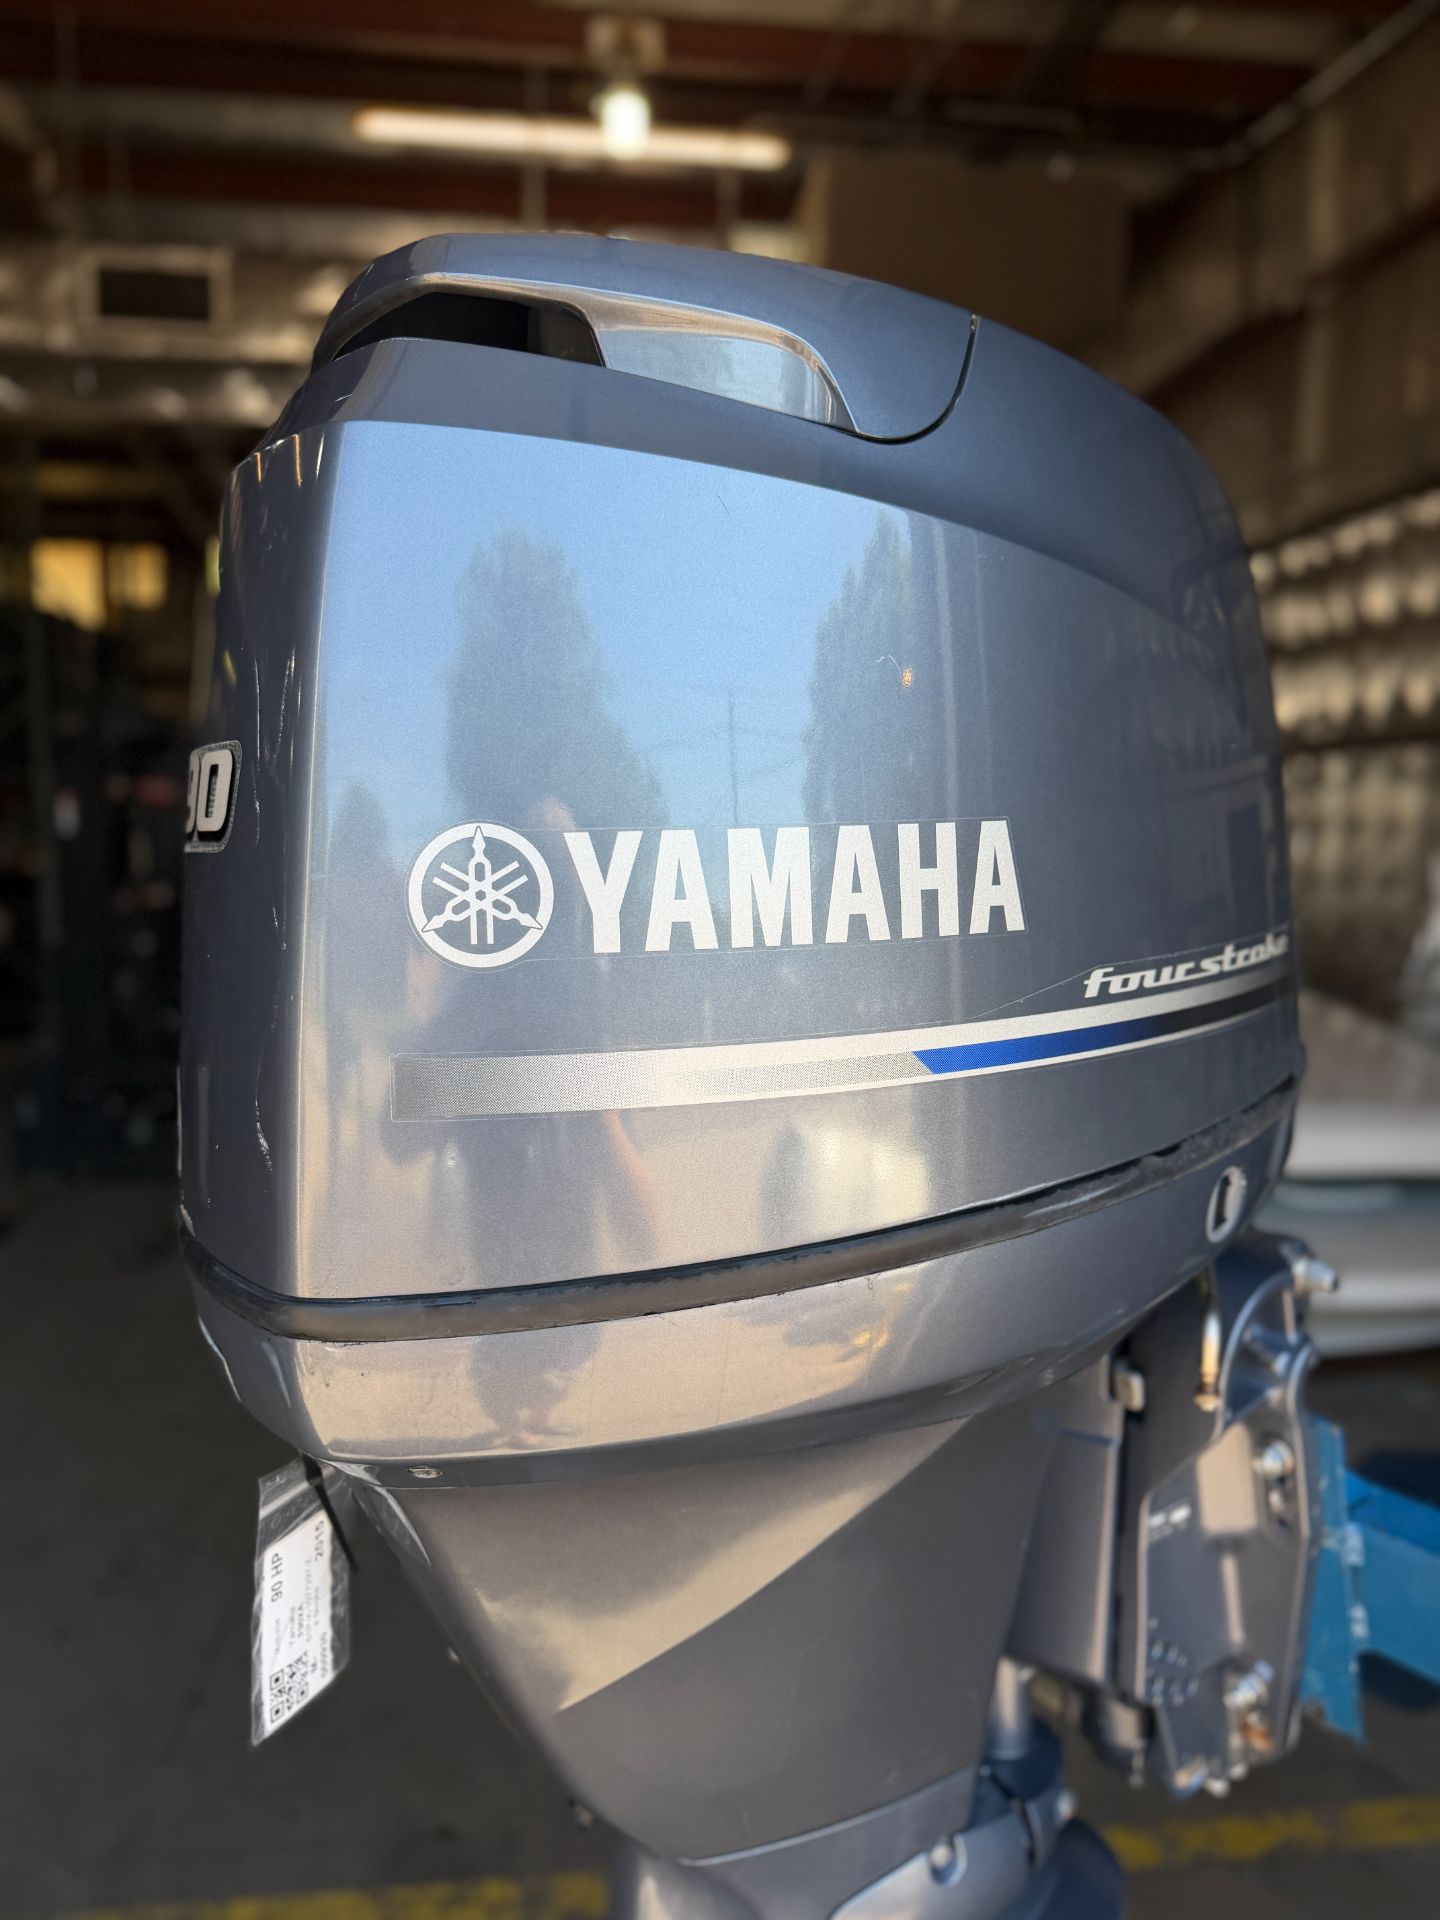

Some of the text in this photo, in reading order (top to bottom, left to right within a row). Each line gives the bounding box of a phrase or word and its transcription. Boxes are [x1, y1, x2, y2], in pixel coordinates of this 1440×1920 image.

[564, 820, 1026, 954] YAMAHA
[271, 1552, 284, 1578] HP
[271, 1580, 284, 1604] 90
